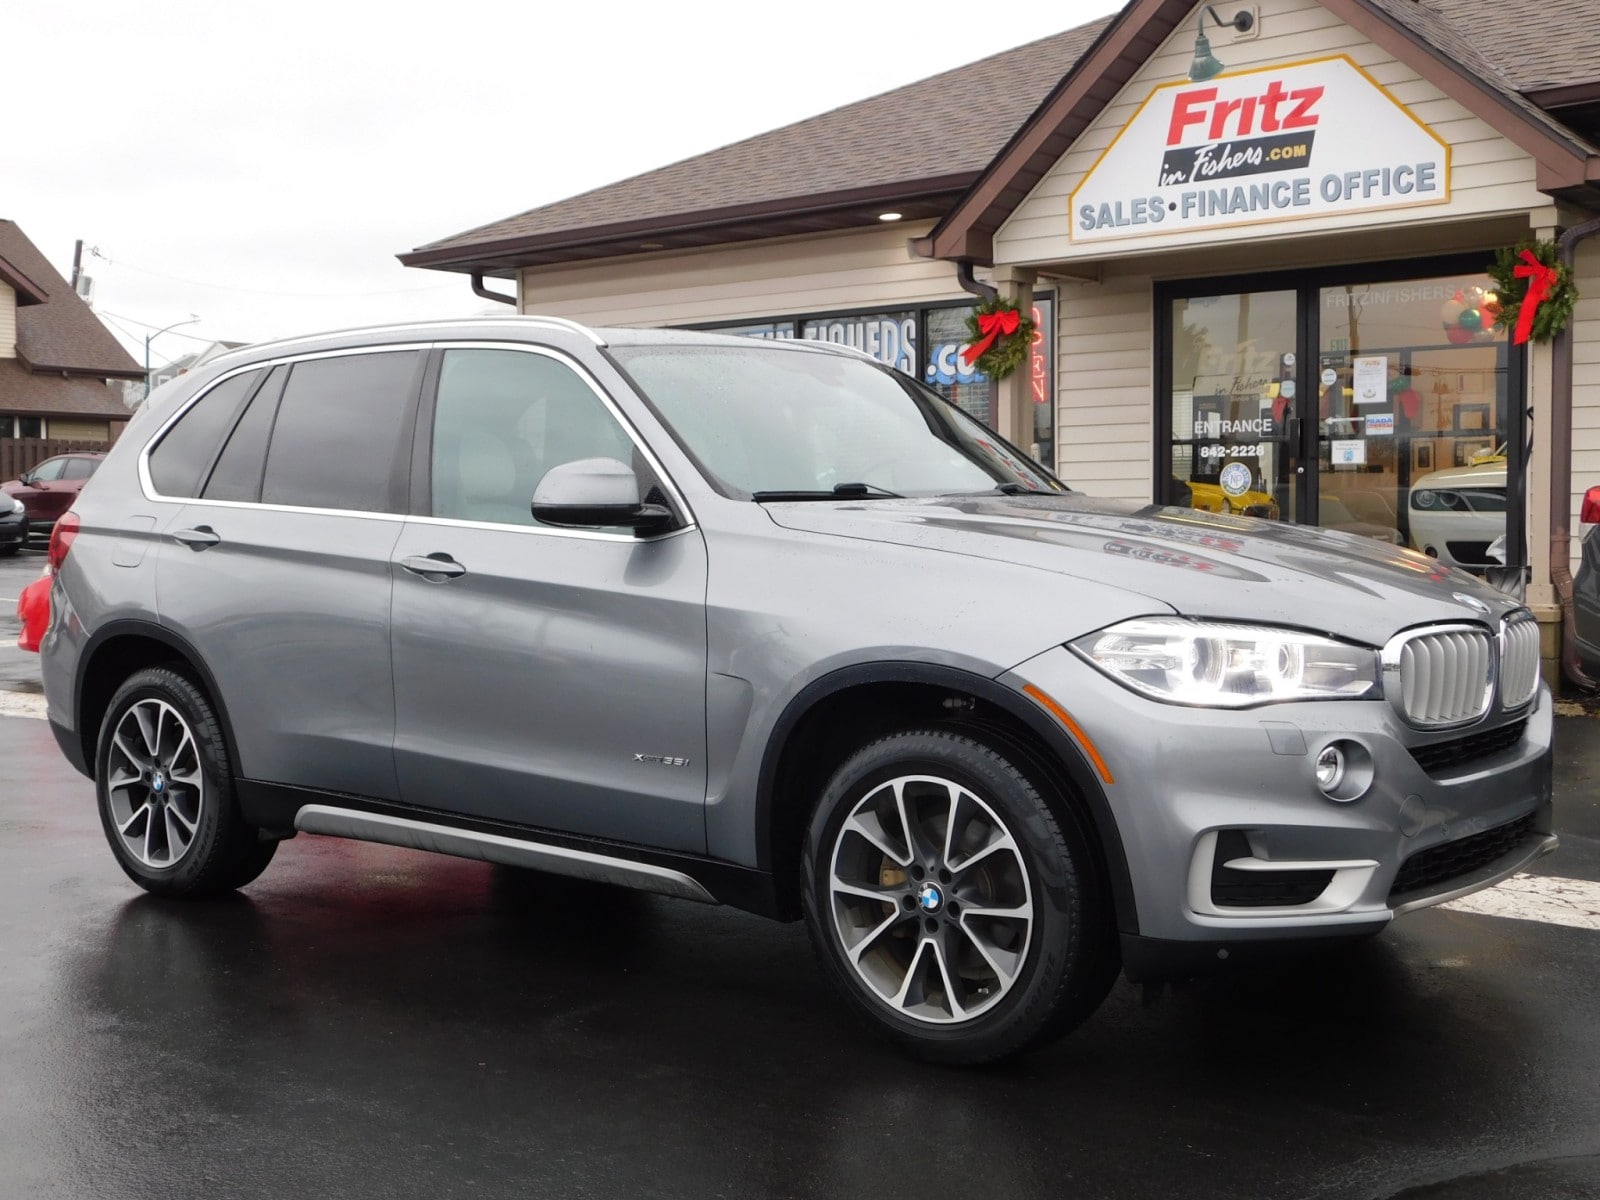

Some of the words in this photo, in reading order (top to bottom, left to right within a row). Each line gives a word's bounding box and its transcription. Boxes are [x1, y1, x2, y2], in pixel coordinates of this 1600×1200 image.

[1166, 80, 1325, 146] Fritz
[1160, 164, 1186, 187] in
[1189, 144, 1264, 183] Fishers
[1079, 195, 1165, 231] SALES
[1181, 177, 1311, 219] FINANCE
[1319, 161, 1437, 203] OFFICE
[1194, 418, 1273, 434] ENTRANCE
[1200, 444, 1265, 458] 842-2228
